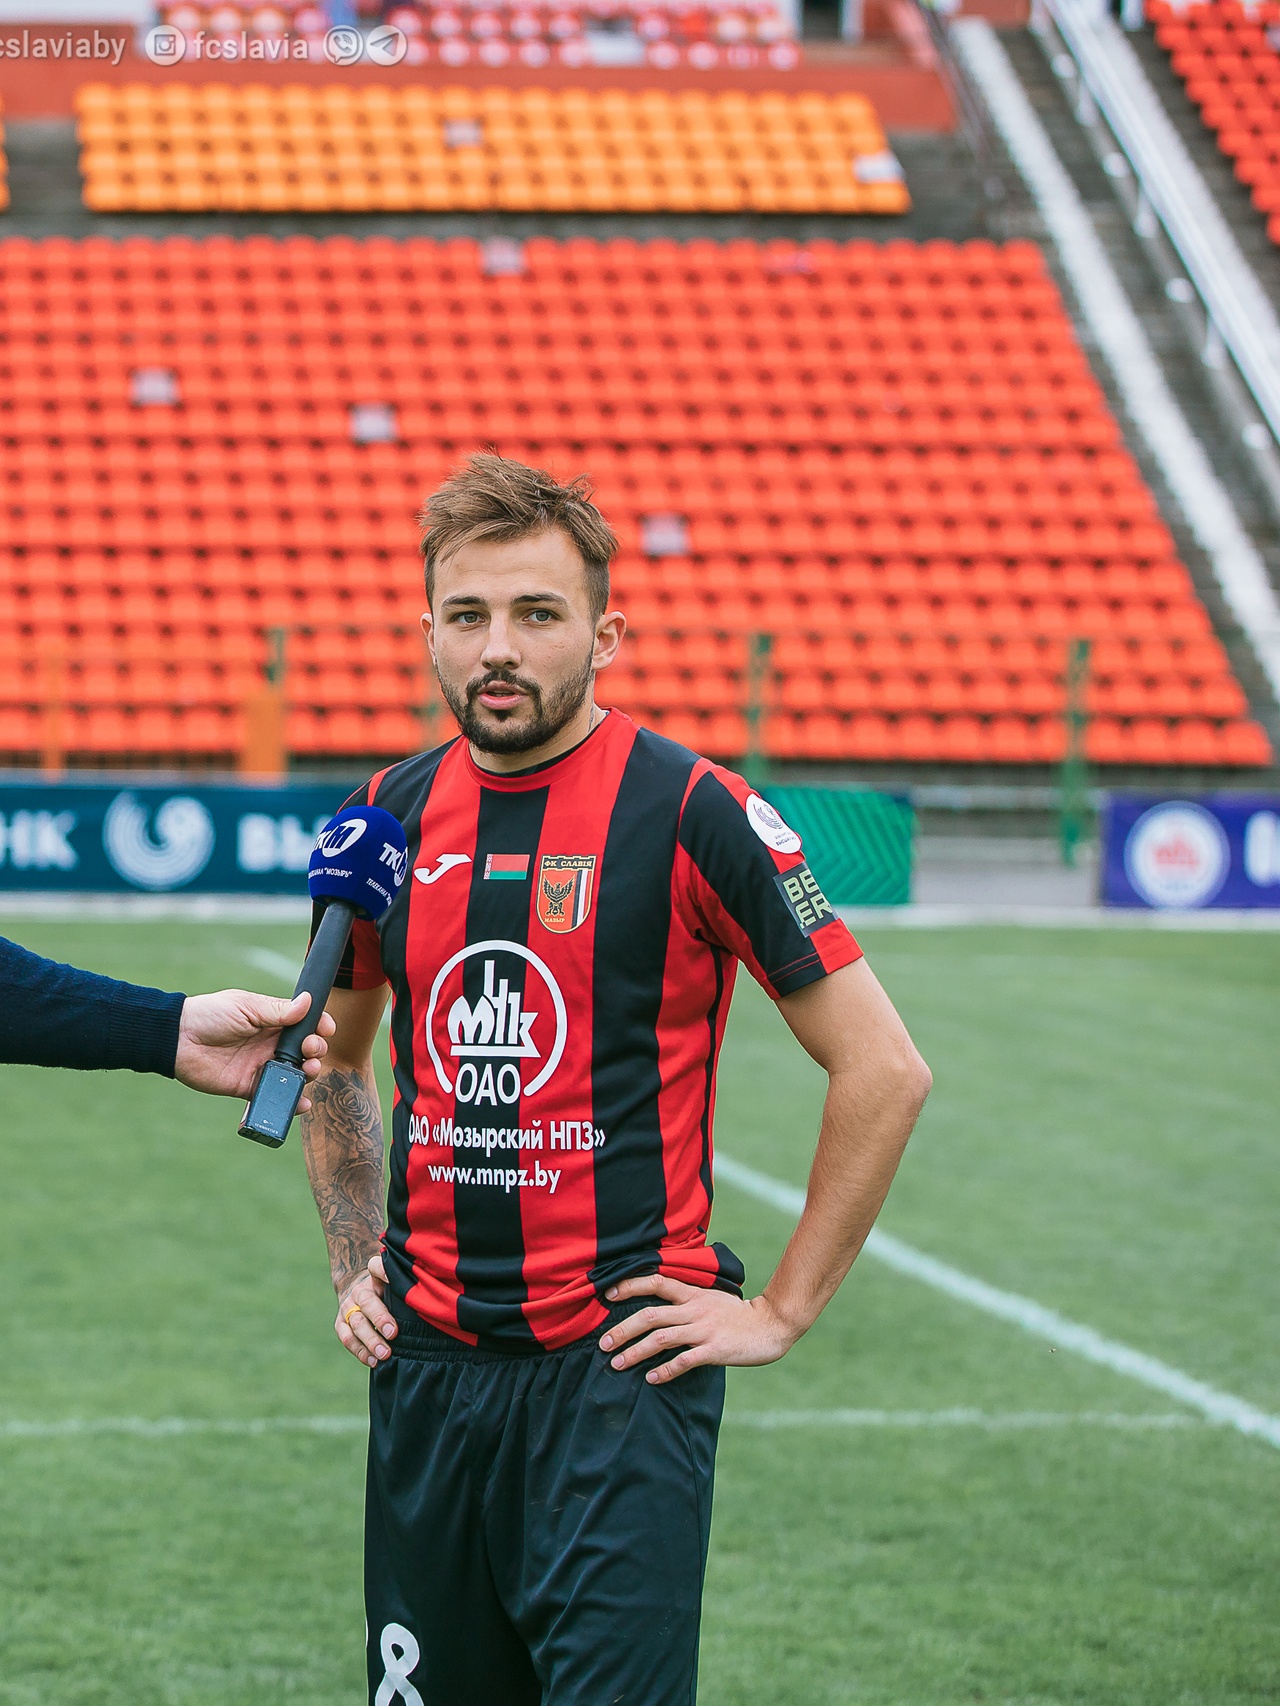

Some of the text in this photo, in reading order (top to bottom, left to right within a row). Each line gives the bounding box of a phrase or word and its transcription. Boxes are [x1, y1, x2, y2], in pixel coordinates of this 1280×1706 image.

[455, 1063, 521, 1106] ОАО
[408, 1113, 430, 1146] ОАО
[427, 1160, 562, 1194] www.mnpz.by
